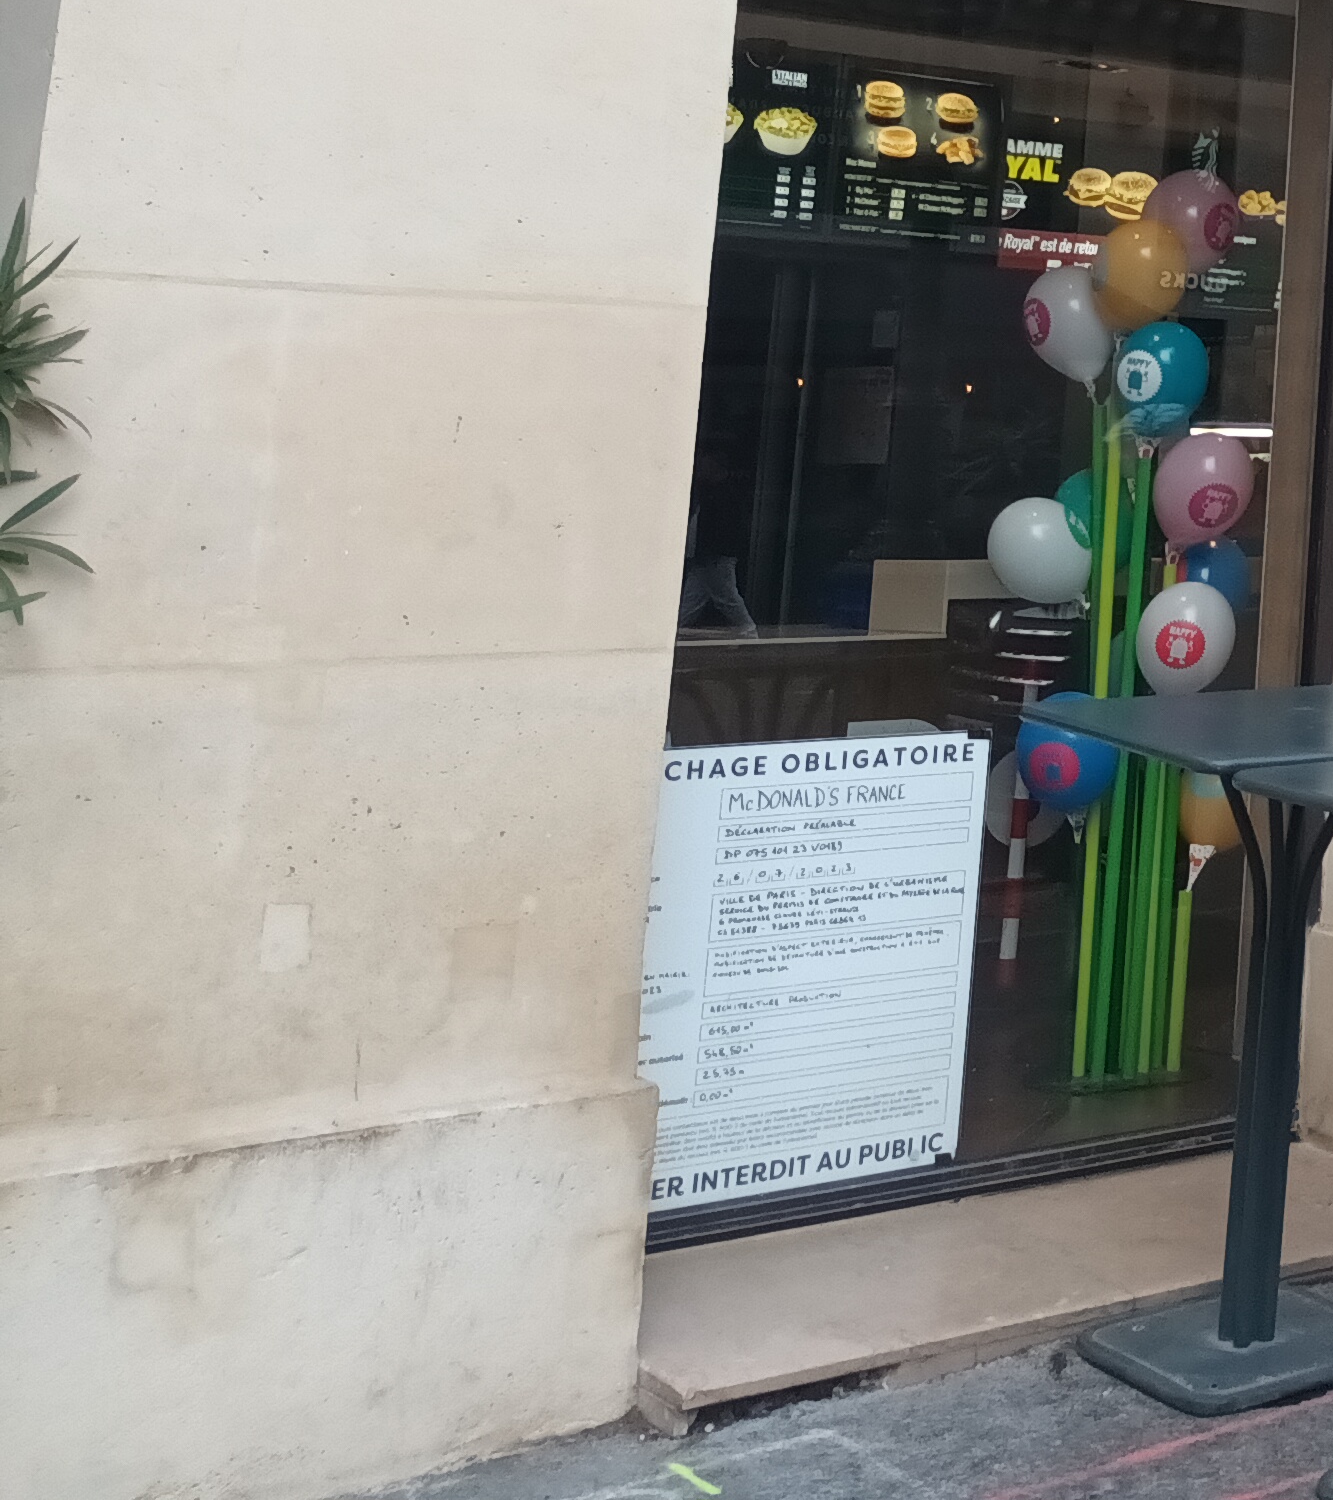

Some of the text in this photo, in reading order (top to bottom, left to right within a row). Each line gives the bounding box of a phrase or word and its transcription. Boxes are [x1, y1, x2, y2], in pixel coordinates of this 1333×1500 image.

[664, 743, 975, 782] CHAGE OBLIGATOIRE
[847, 783, 906, 804] FRANCE
[793, 844, 807, 854] 23
[651, 1176, 684, 1200] ER
[692, 1154, 811, 1194] INTERDIT
[816, 1147, 852, 1173] AU
